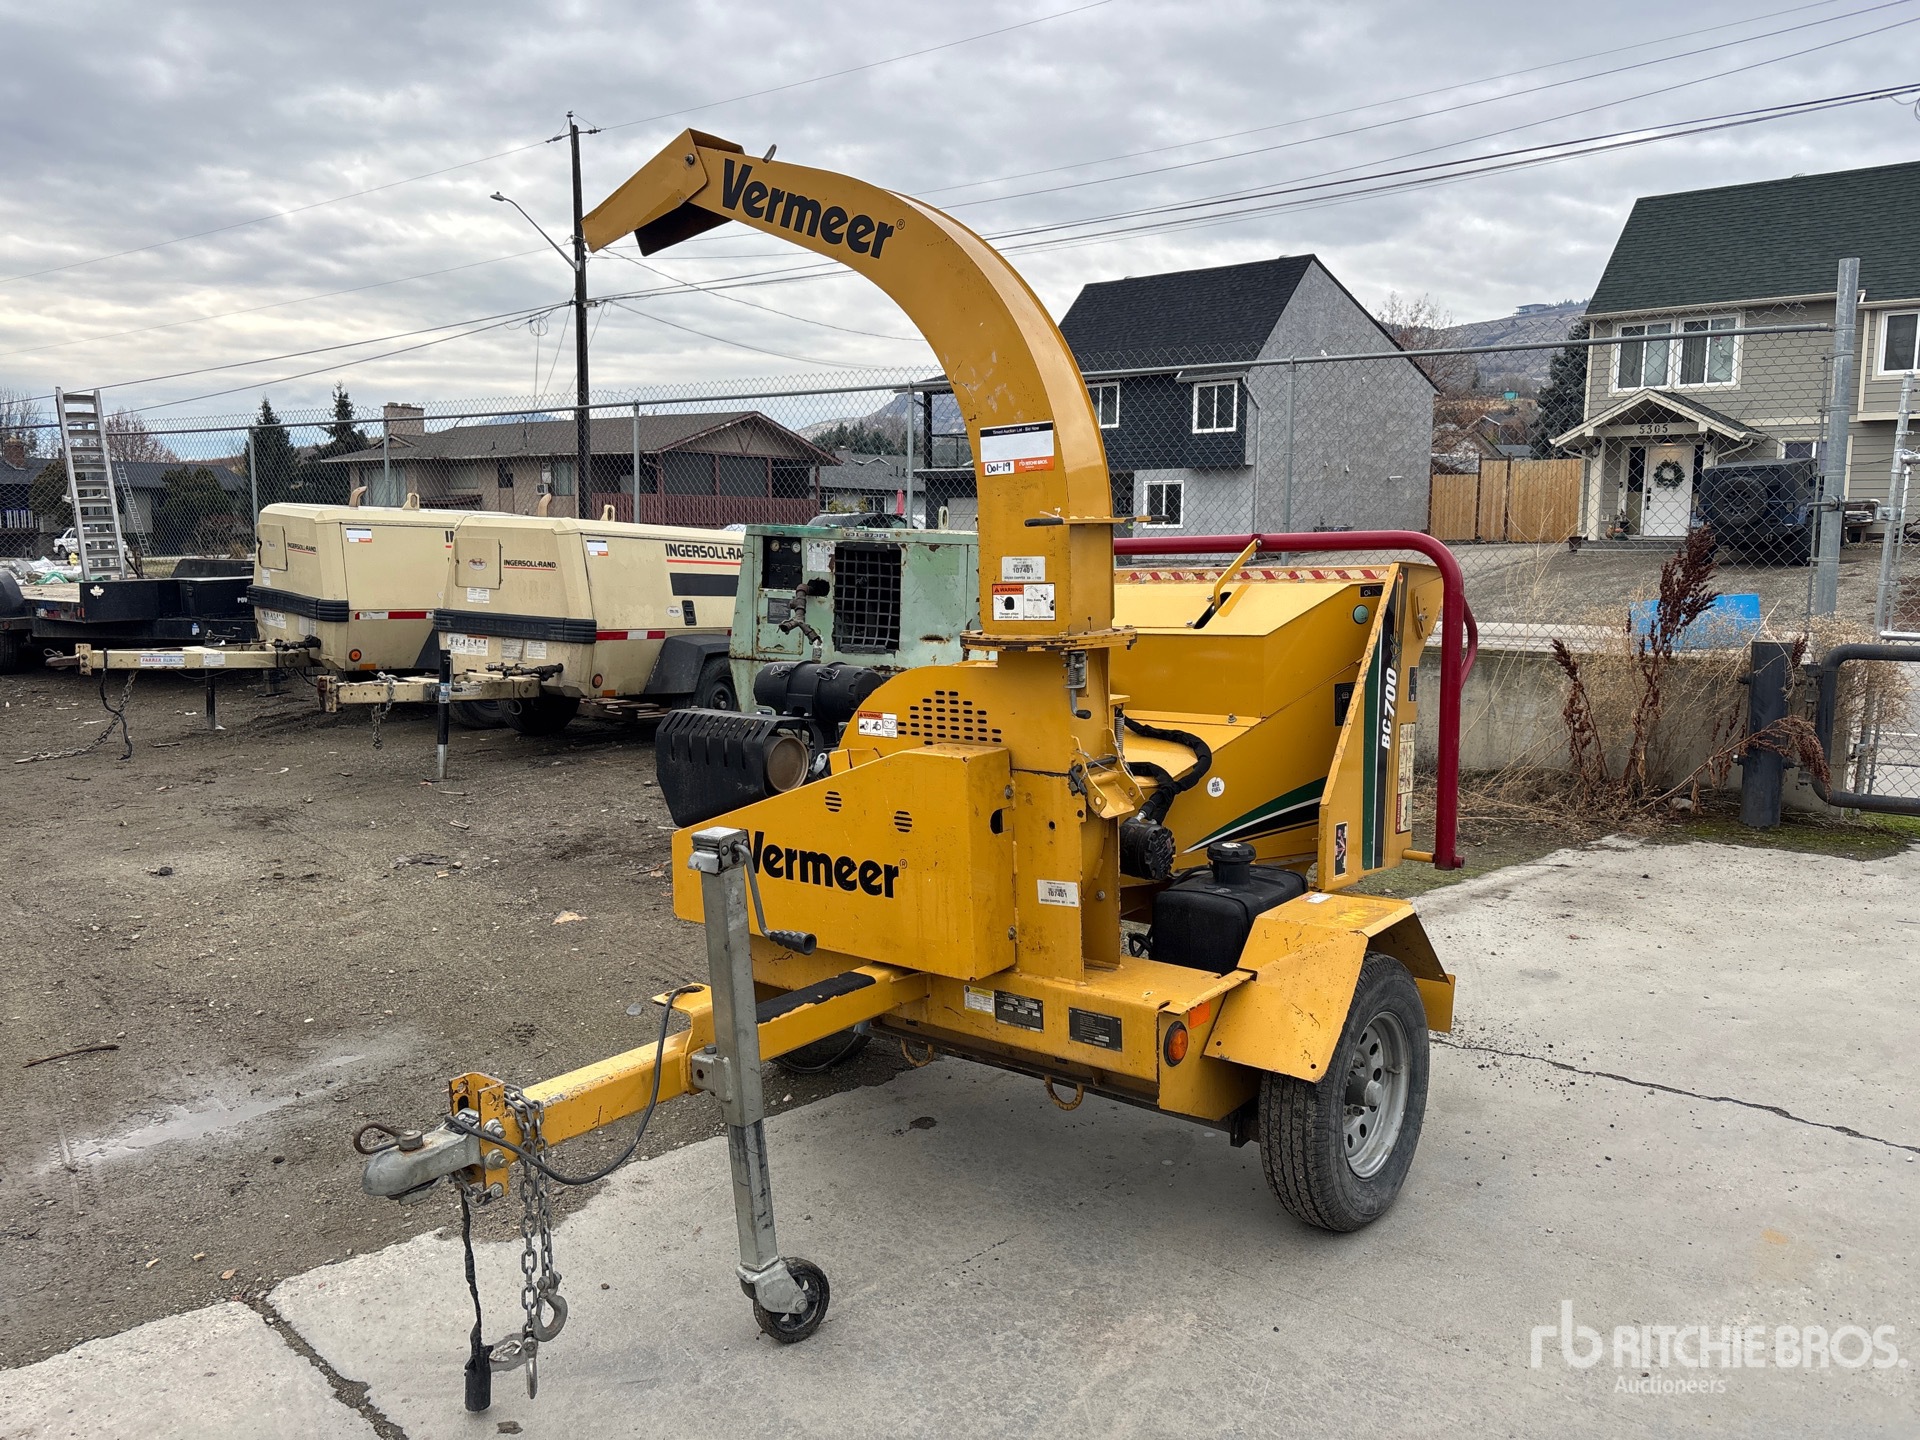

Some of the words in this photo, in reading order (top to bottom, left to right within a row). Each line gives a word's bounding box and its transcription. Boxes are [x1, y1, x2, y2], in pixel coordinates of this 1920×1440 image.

[1639, 424, 1669, 434] 5305
[287, 542, 317, 553] INGERSOLL-RAND
[503, 559, 557, 569] INGERSOLL-RAND
